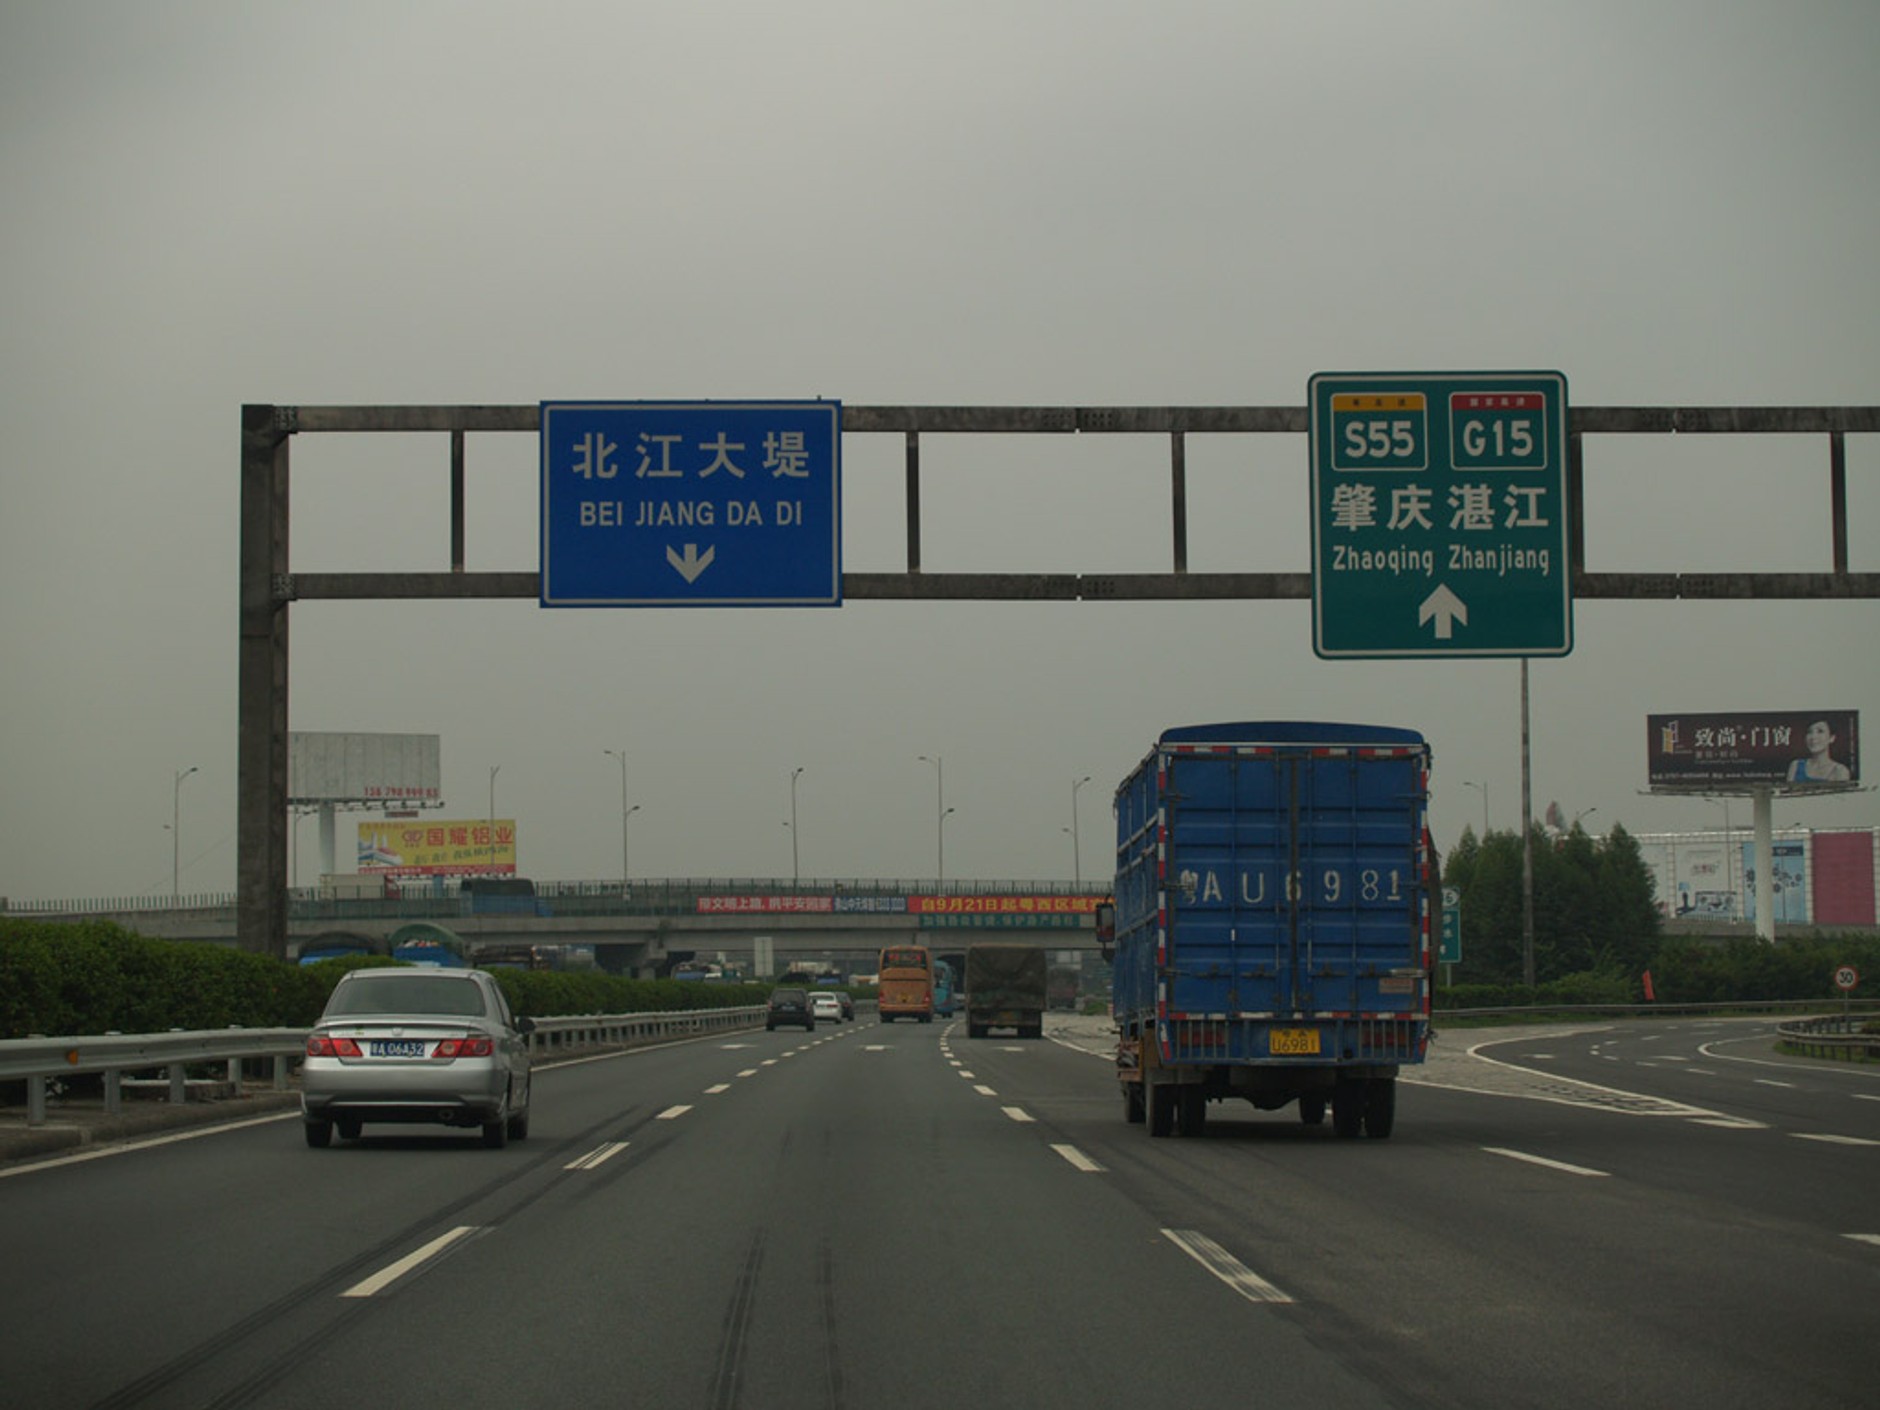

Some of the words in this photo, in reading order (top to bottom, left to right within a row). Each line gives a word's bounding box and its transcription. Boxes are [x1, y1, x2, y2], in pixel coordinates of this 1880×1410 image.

[572, 431, 809, 479] 北江大堤
[1345, 420, 1415, 458] S55
[1463, 420, 1533, 457] G15
[579, 501, 623, 527] BEI
[635, 501, 715, 527] JIANG
[727, 501, 763, 527] DA
[776, 501, 802, 526] DI
[1331, 483, 1433, 531] 肇庆
[1446, 483, 1549, 530] 湛江
[1332, 545, 1434, 577] Zhaoqing
[1448, 544, 1549, 576] Zhanjiang
[1839, 972, 1854, 983] 30
[1272, 1038, 1317, 1052] U6981
